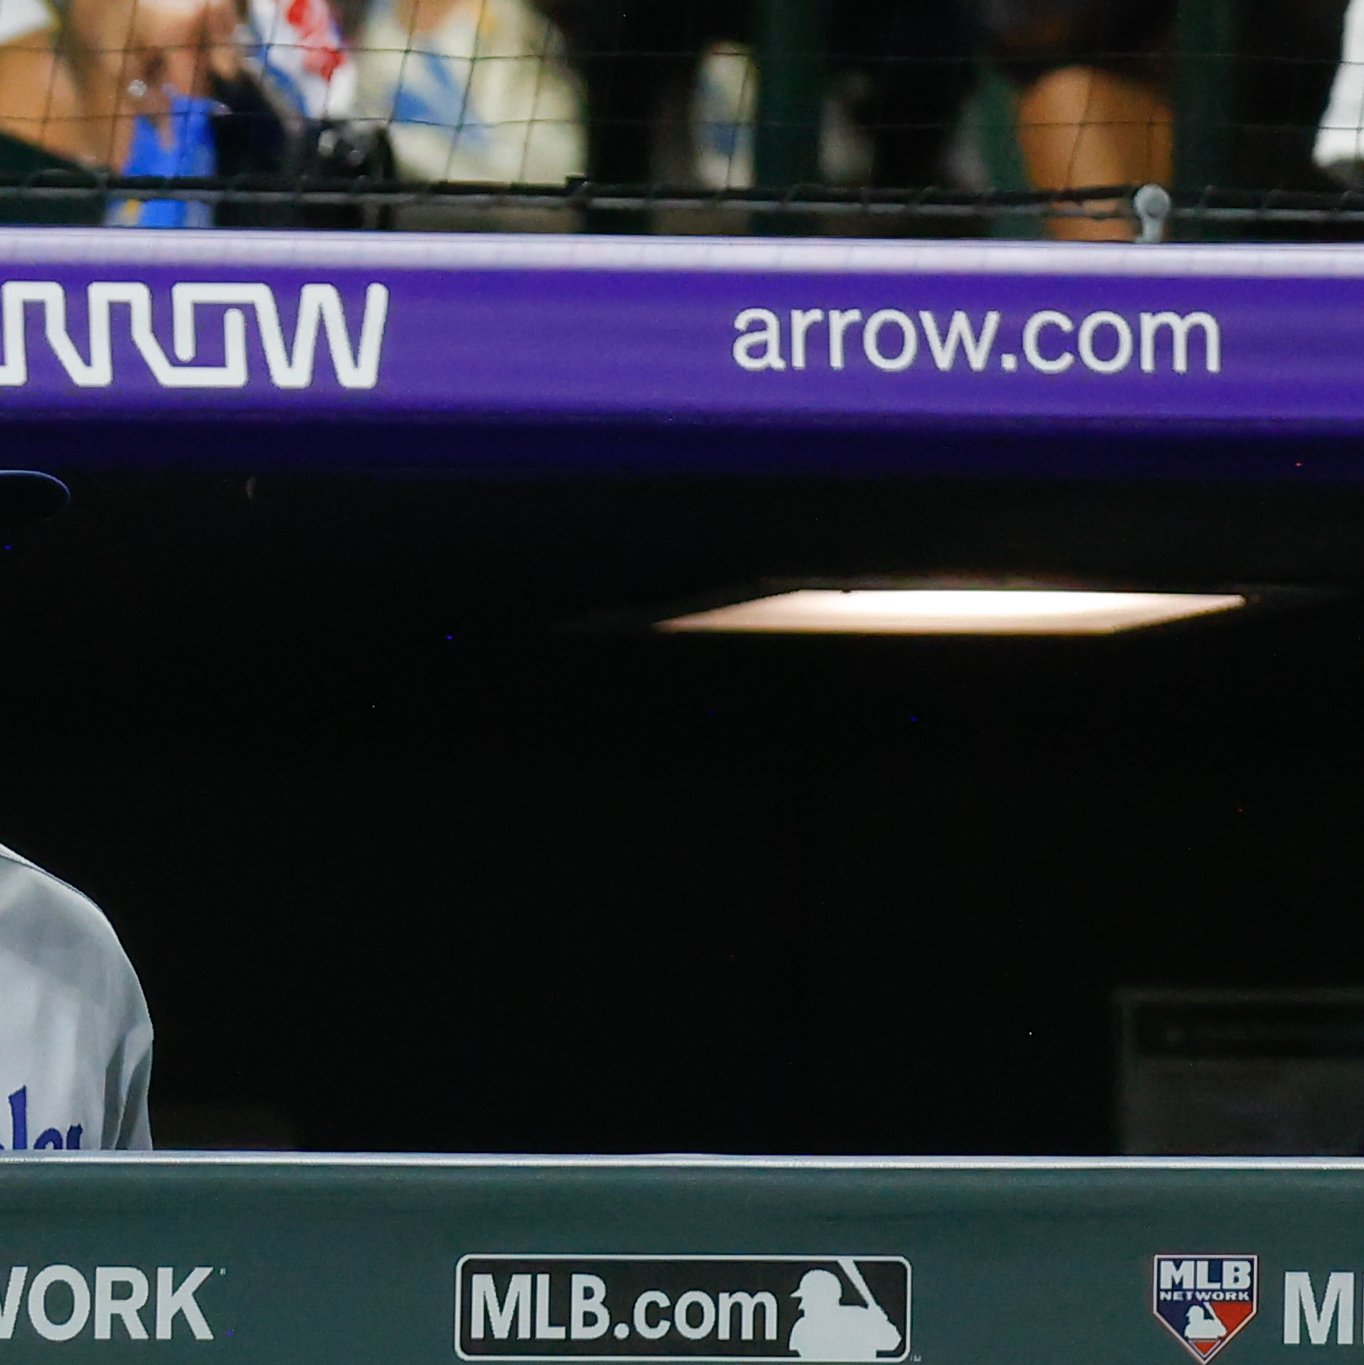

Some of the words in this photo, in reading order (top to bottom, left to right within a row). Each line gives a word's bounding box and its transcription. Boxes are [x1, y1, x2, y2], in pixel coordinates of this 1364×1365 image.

[733, 308, 1220, 373] arrow.com
[1159, 1291, 1250, 1301] NETWORK
[1160, 1260, 1251, 1289] MLB
[471, 1274, 777, 1340] MLB.com
